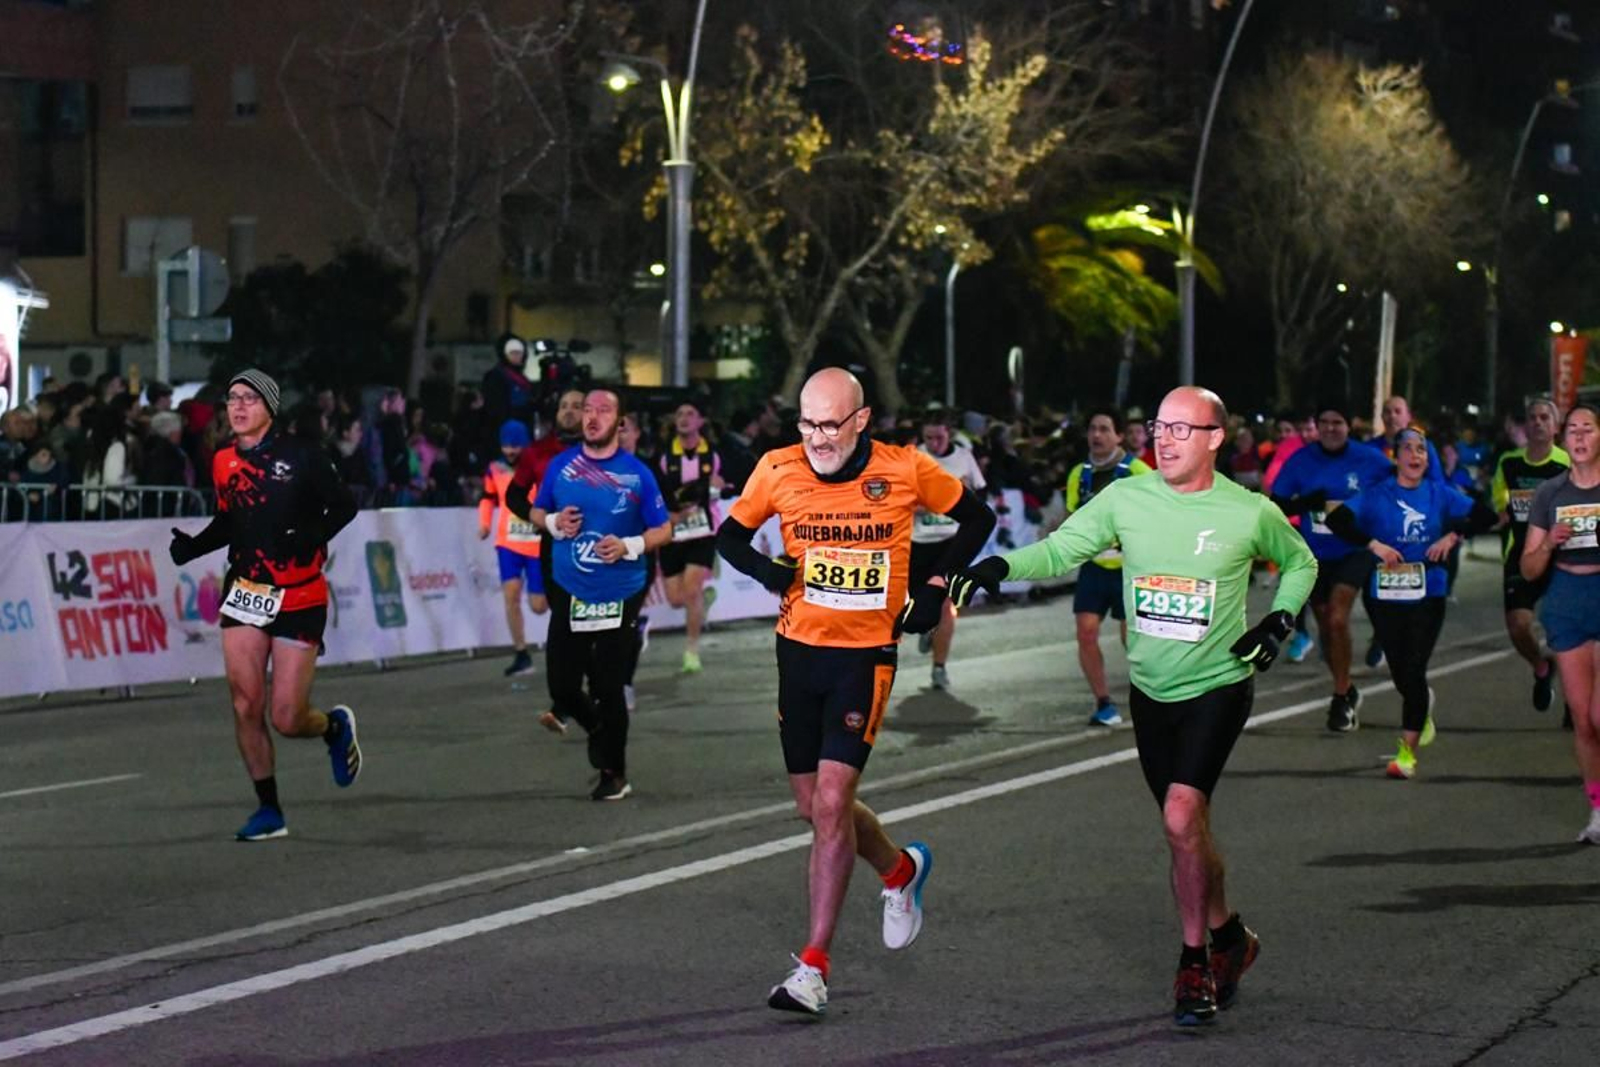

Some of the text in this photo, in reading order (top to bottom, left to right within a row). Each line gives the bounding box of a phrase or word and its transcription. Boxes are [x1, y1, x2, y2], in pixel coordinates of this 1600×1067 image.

[47, 550, 92, 600] 42
[91, 548, 157, 602] SAN
[812, 563, 880, 588] 3818
[1381, 573, 1421, 587] 2225
[233, 588, 275, 613] 9660
[575, 601, 619, 618] 2482
[1138, 590, 1206, 619] 2932
